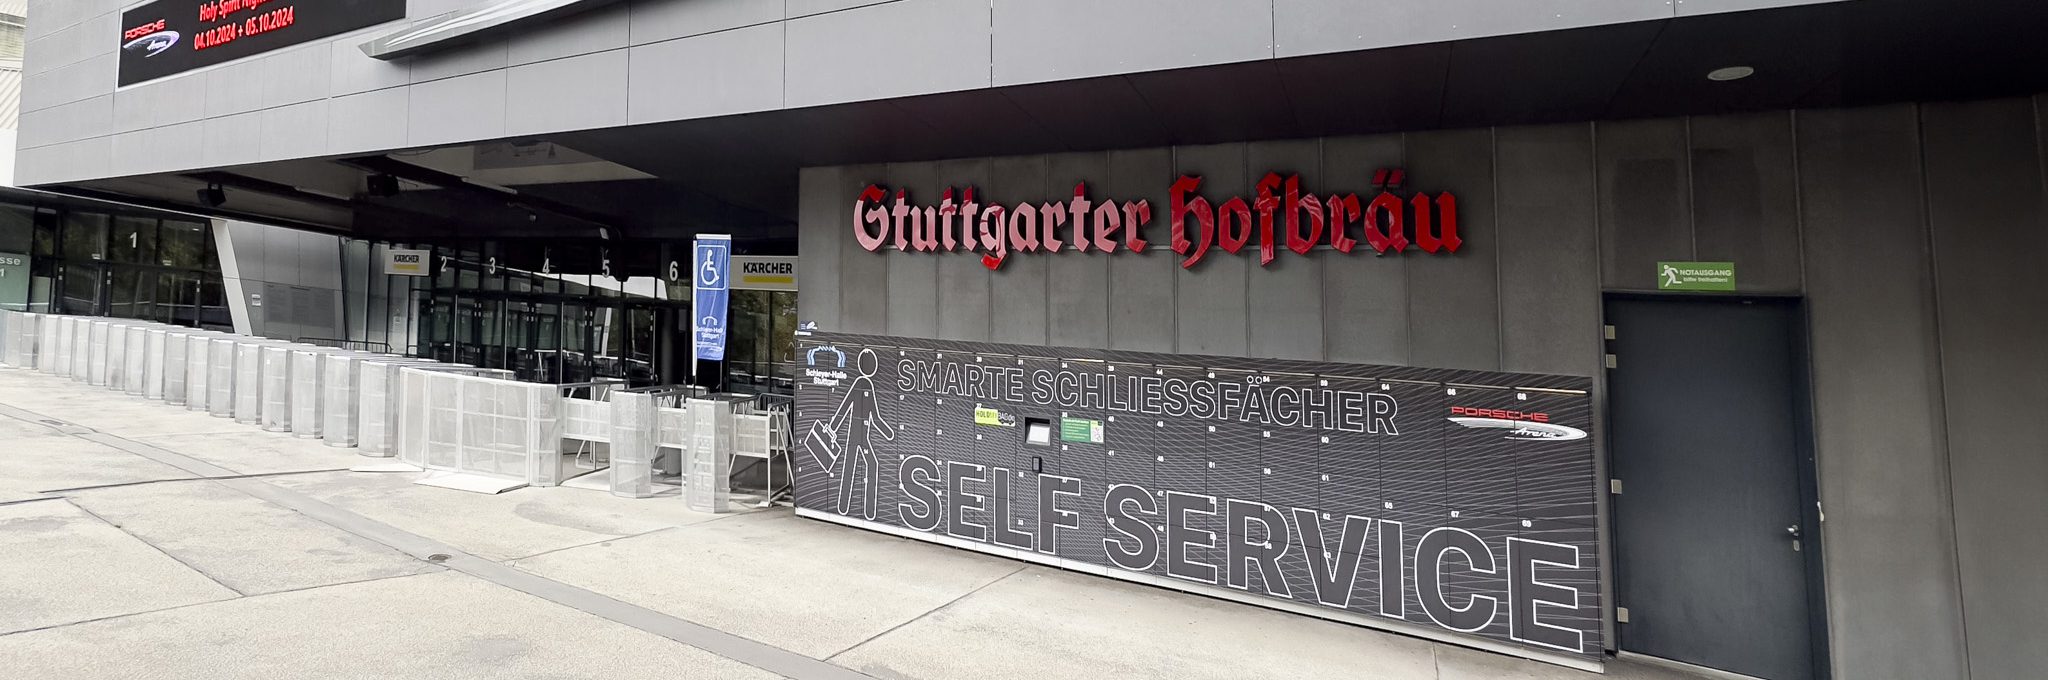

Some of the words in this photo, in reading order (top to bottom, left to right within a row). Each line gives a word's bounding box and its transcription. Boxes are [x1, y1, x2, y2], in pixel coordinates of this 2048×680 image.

[200, 1, 218, 22] Holy
[125, 19, 166, 40] PORSCHE
[194, 22, 236, 50] 04.10.2024
[237, 25, 243, 37] +
[245, 6, 294, 36] 05.10.2024
[854, 180, 1153, 271] Stuttgarter
[1169, 169, 1463, 270] Hofbräu
[130, 232, 137, 248] 1
[440, 256, 447, 272] 2
[489, 257, 496, 275] 3
[542, 257, 550, 274] 4
[602, 259, 610, 277] 5
[669, 261, 678, 282] 6
[743, 262, 793, 274] KÄRCHER
[1680, 269, 1732, 277] NOTAUSGANG
[898, 359, 1024, 402] SMARTE
[1032, 369, 1399, 435] SCHLIESSFÄCHER
[1451, 406, 1549, 422] PORSCHE
[1513, 427, 1556, 438] Arena
[899, 455, 1082, 555] SELF
[1103, 483, 1584, 653] SERVICE
